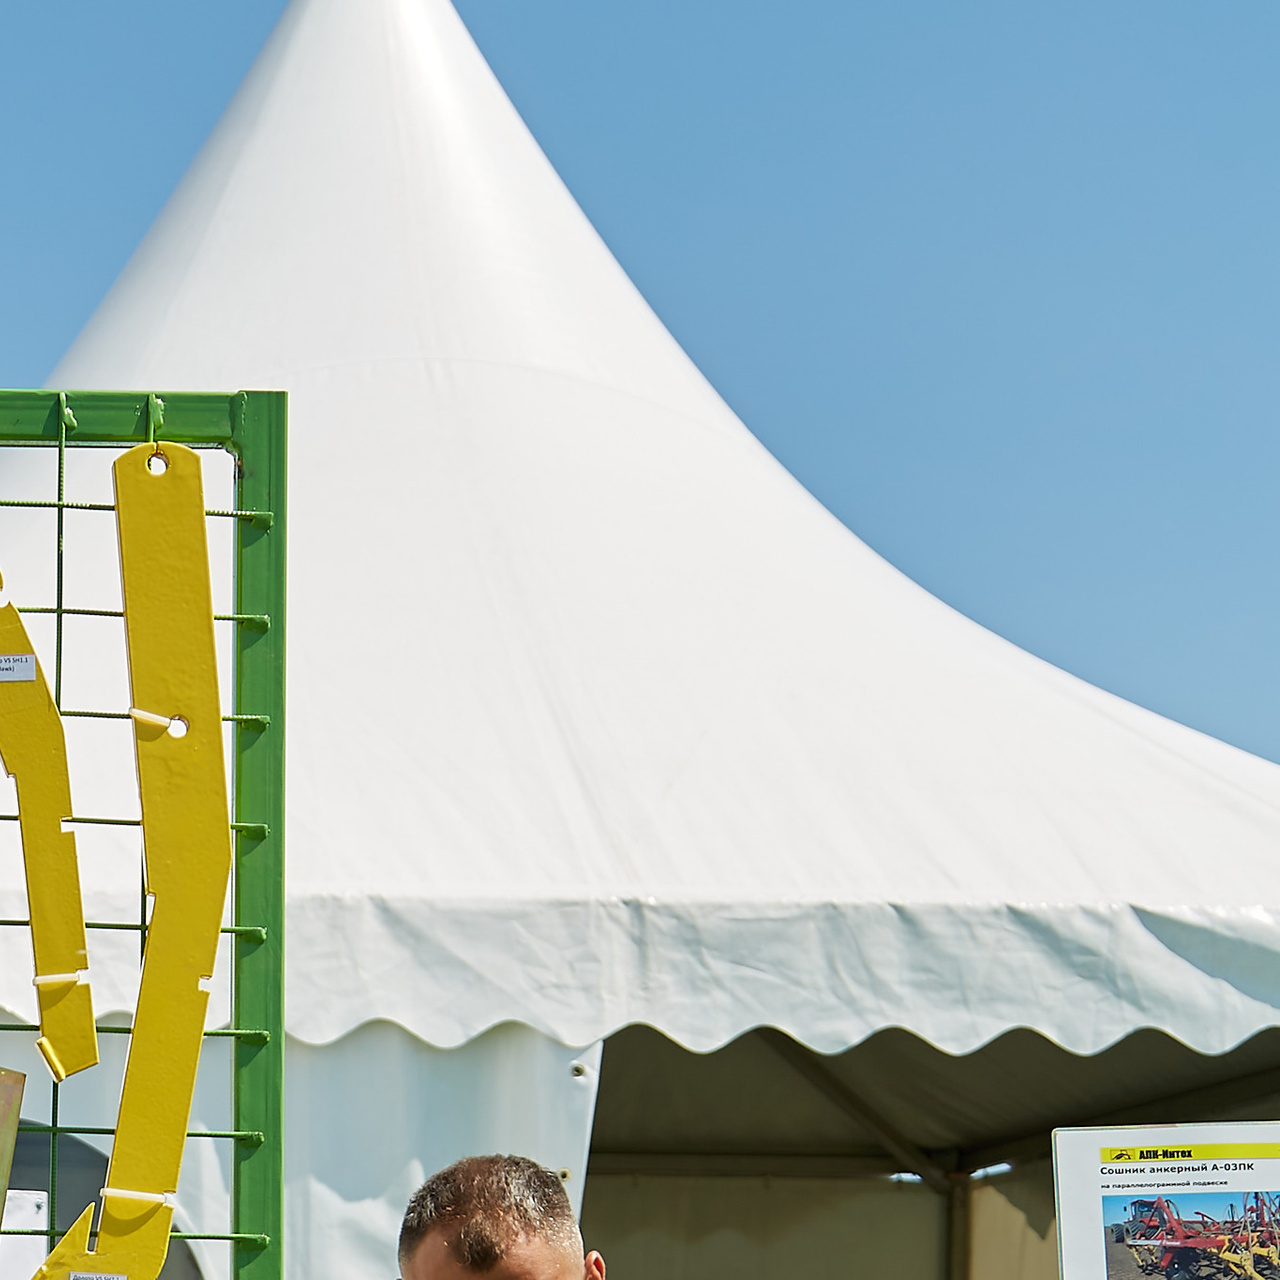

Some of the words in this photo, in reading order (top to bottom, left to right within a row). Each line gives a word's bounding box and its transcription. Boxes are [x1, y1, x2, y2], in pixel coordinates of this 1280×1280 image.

[1100, 1166, 1146, 1175] Сошник
[1149, 1163, 1208, 1175] анкерный
[1211, 1163, 1254, 1171] А-03ПК
